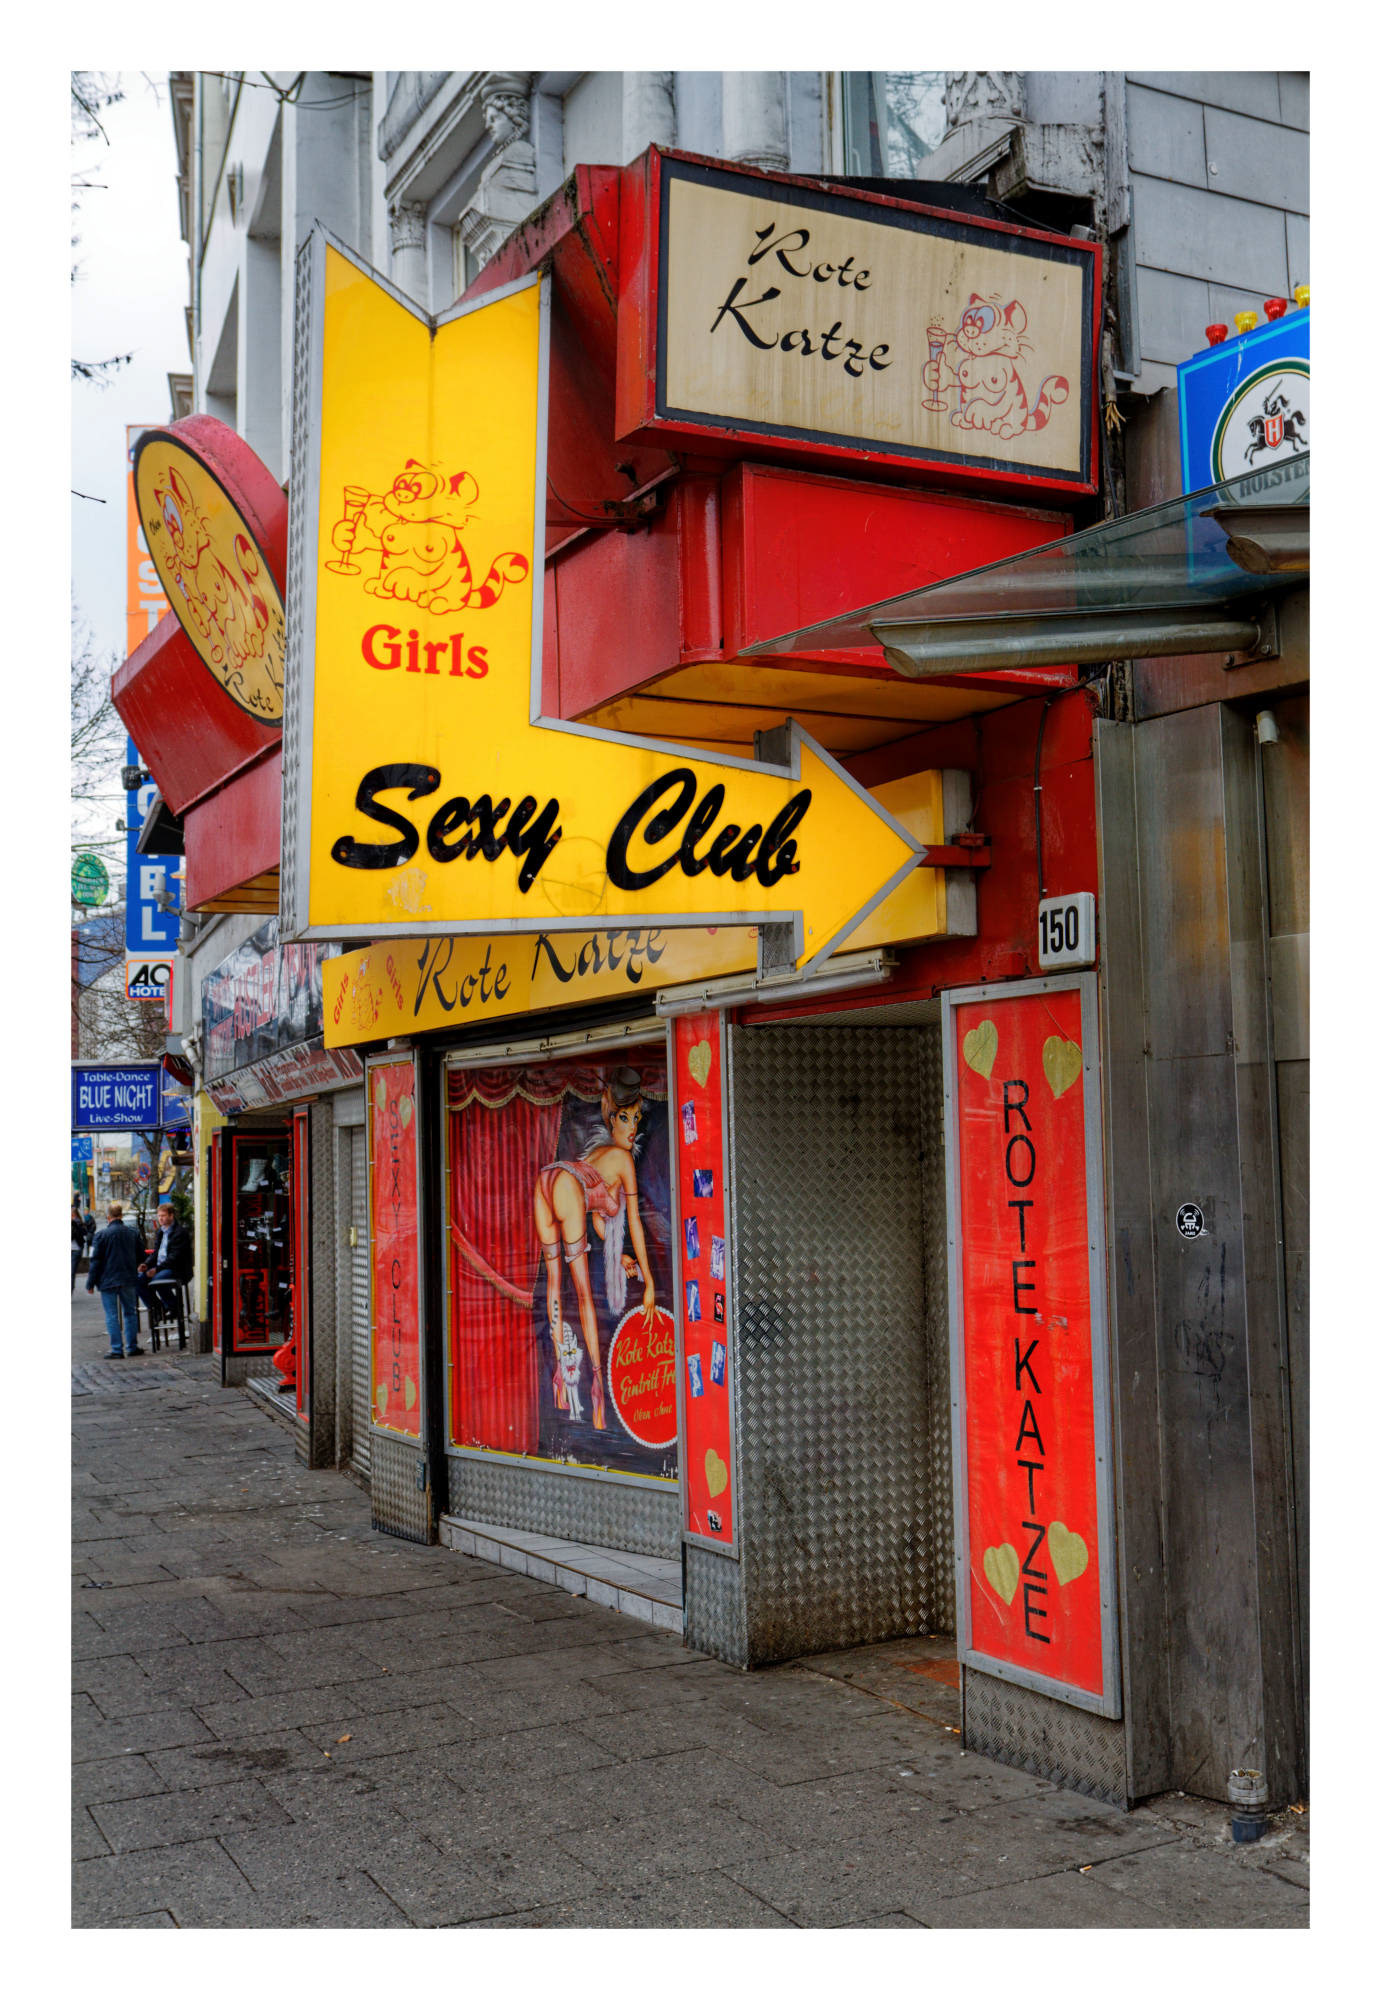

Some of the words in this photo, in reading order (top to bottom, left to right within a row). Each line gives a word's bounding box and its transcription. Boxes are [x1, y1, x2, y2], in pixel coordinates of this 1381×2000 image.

[748, 222, 873, 291] Rote
[711, 277, 893, 378] Katze
[1239, 461, 1309, 498] HOLSTE
[361, 624, 489, 679] Girls
[331, 763, 562, 895] Sexy
[605, 767, 812, 892] Club
[1039, 905, 1079, 954] 150
[333, 972, 349, 1025] Girls
[385, 955, 404, 1011] Girls
[413, 937, 511, 1017] Rote
[80, 1086, 111, 1109] BLUE
[114, 1084, 154, 1111] NIGHT
[83, 1072, 151, 1082] Table-Dance
[89, 1113, 144, 1124] Live-Show
[389, 1100, 402, 1230] SEXY
[1002, 1080, 1038, 1314] ROTE
[391, 1259, 402, 1393] CLUB
[616, 1338, 644, 1369] Rote
[646, 1331, 675, 1360] Katz
[1014, 1339, 1051, 1645] KATZE
